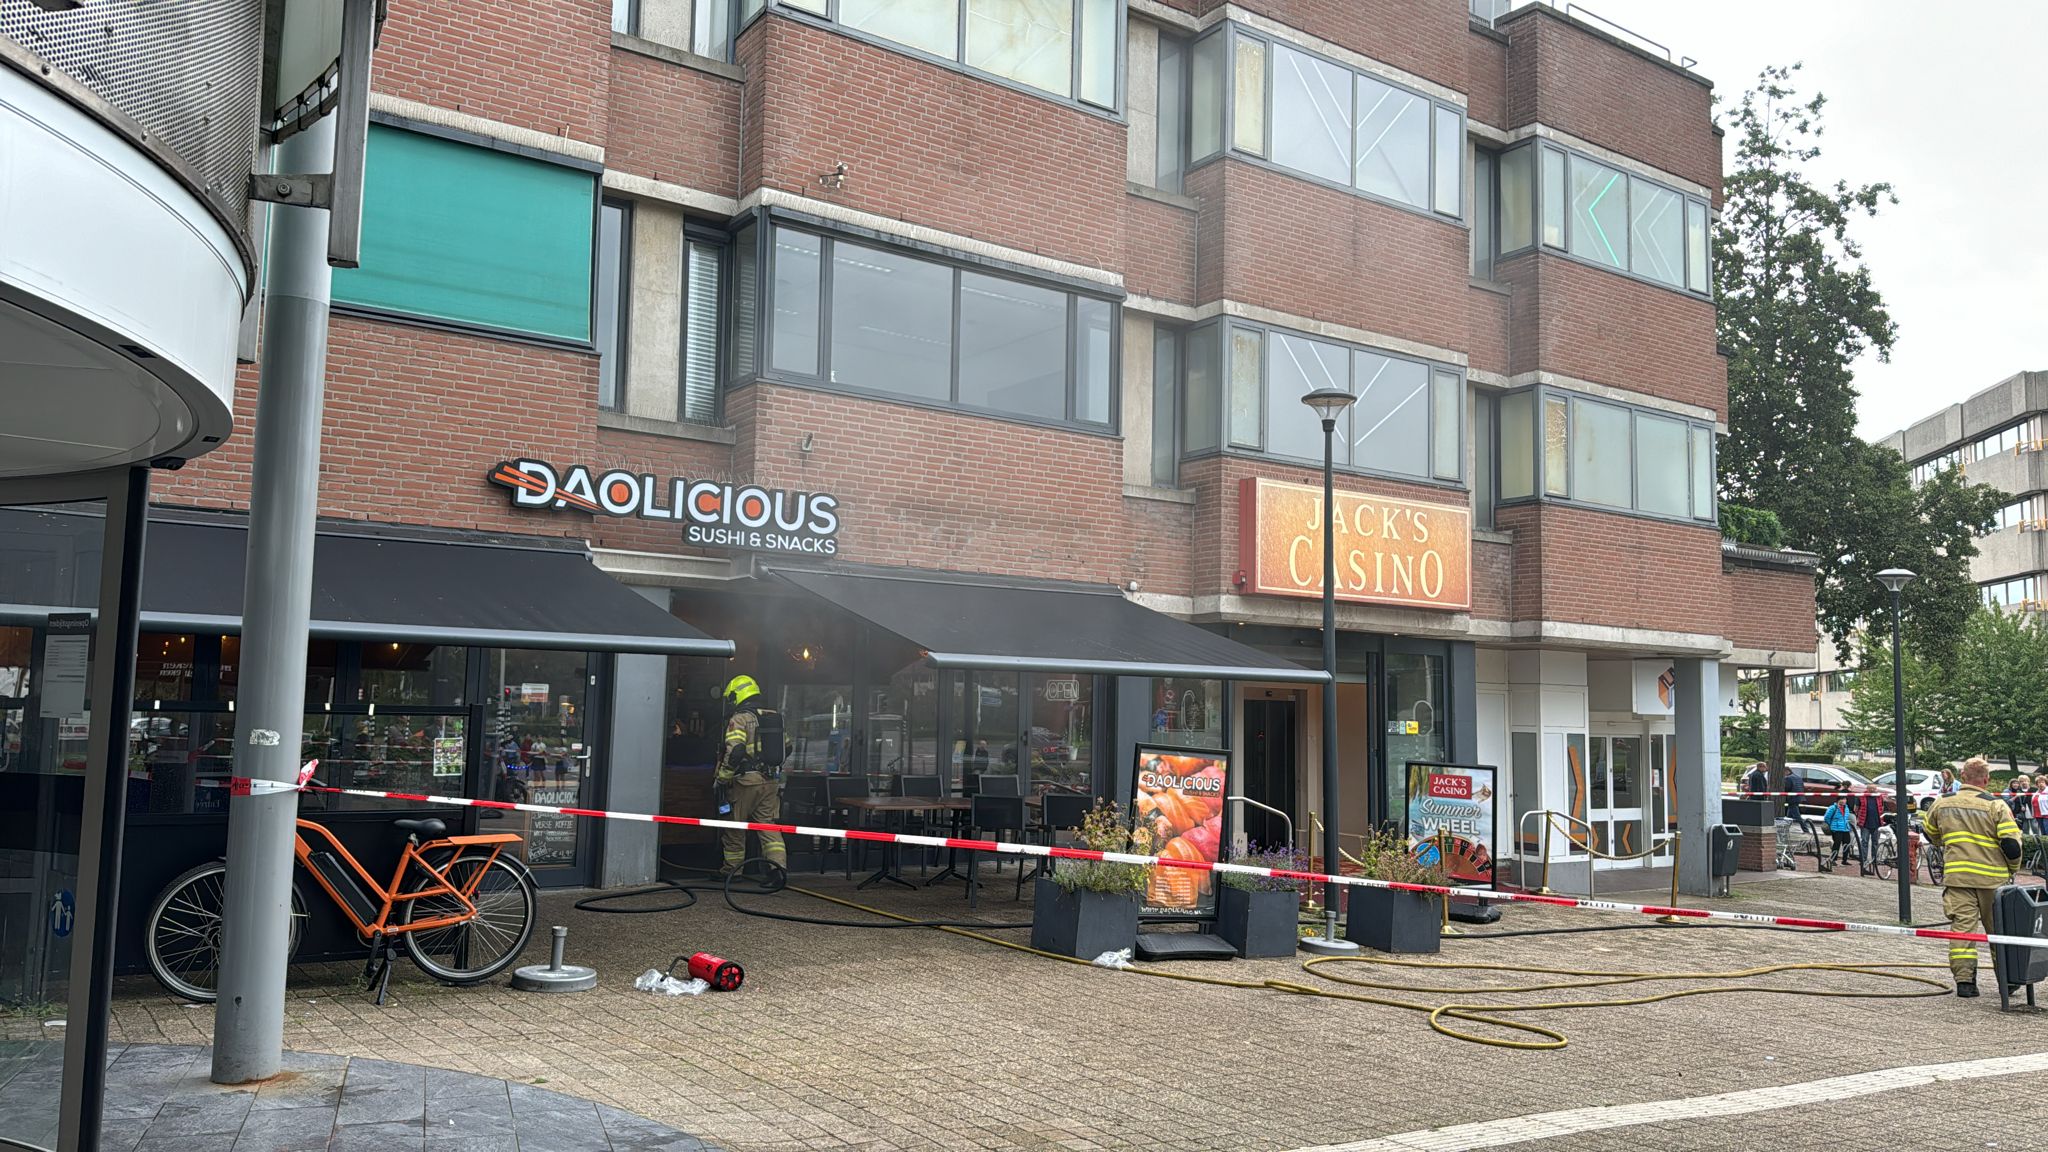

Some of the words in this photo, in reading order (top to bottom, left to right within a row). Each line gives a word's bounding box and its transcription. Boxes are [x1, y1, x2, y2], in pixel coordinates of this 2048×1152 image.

[517, 461, 838, 534] DAOLICIOUS
[1306, 497, 1429, 543] JACK'S
[688, 526, 745, 546] SUSHI
[749, 533, 761, 547] &
[765, 533, 836, 554] SNACKS
[1049, 682, 1078, 698] OPEN
[1728, 698, 1734, 708] 4
[1146, 774, 1221, 791] DAOLICIOUS
[1433, 776, 1467, 786] JACK'S
[1433, 785, 1467, 795] CASINO
[1420, 798, 1482, 818] Summer
[1422, 817, 1480, 834] WHEEL
